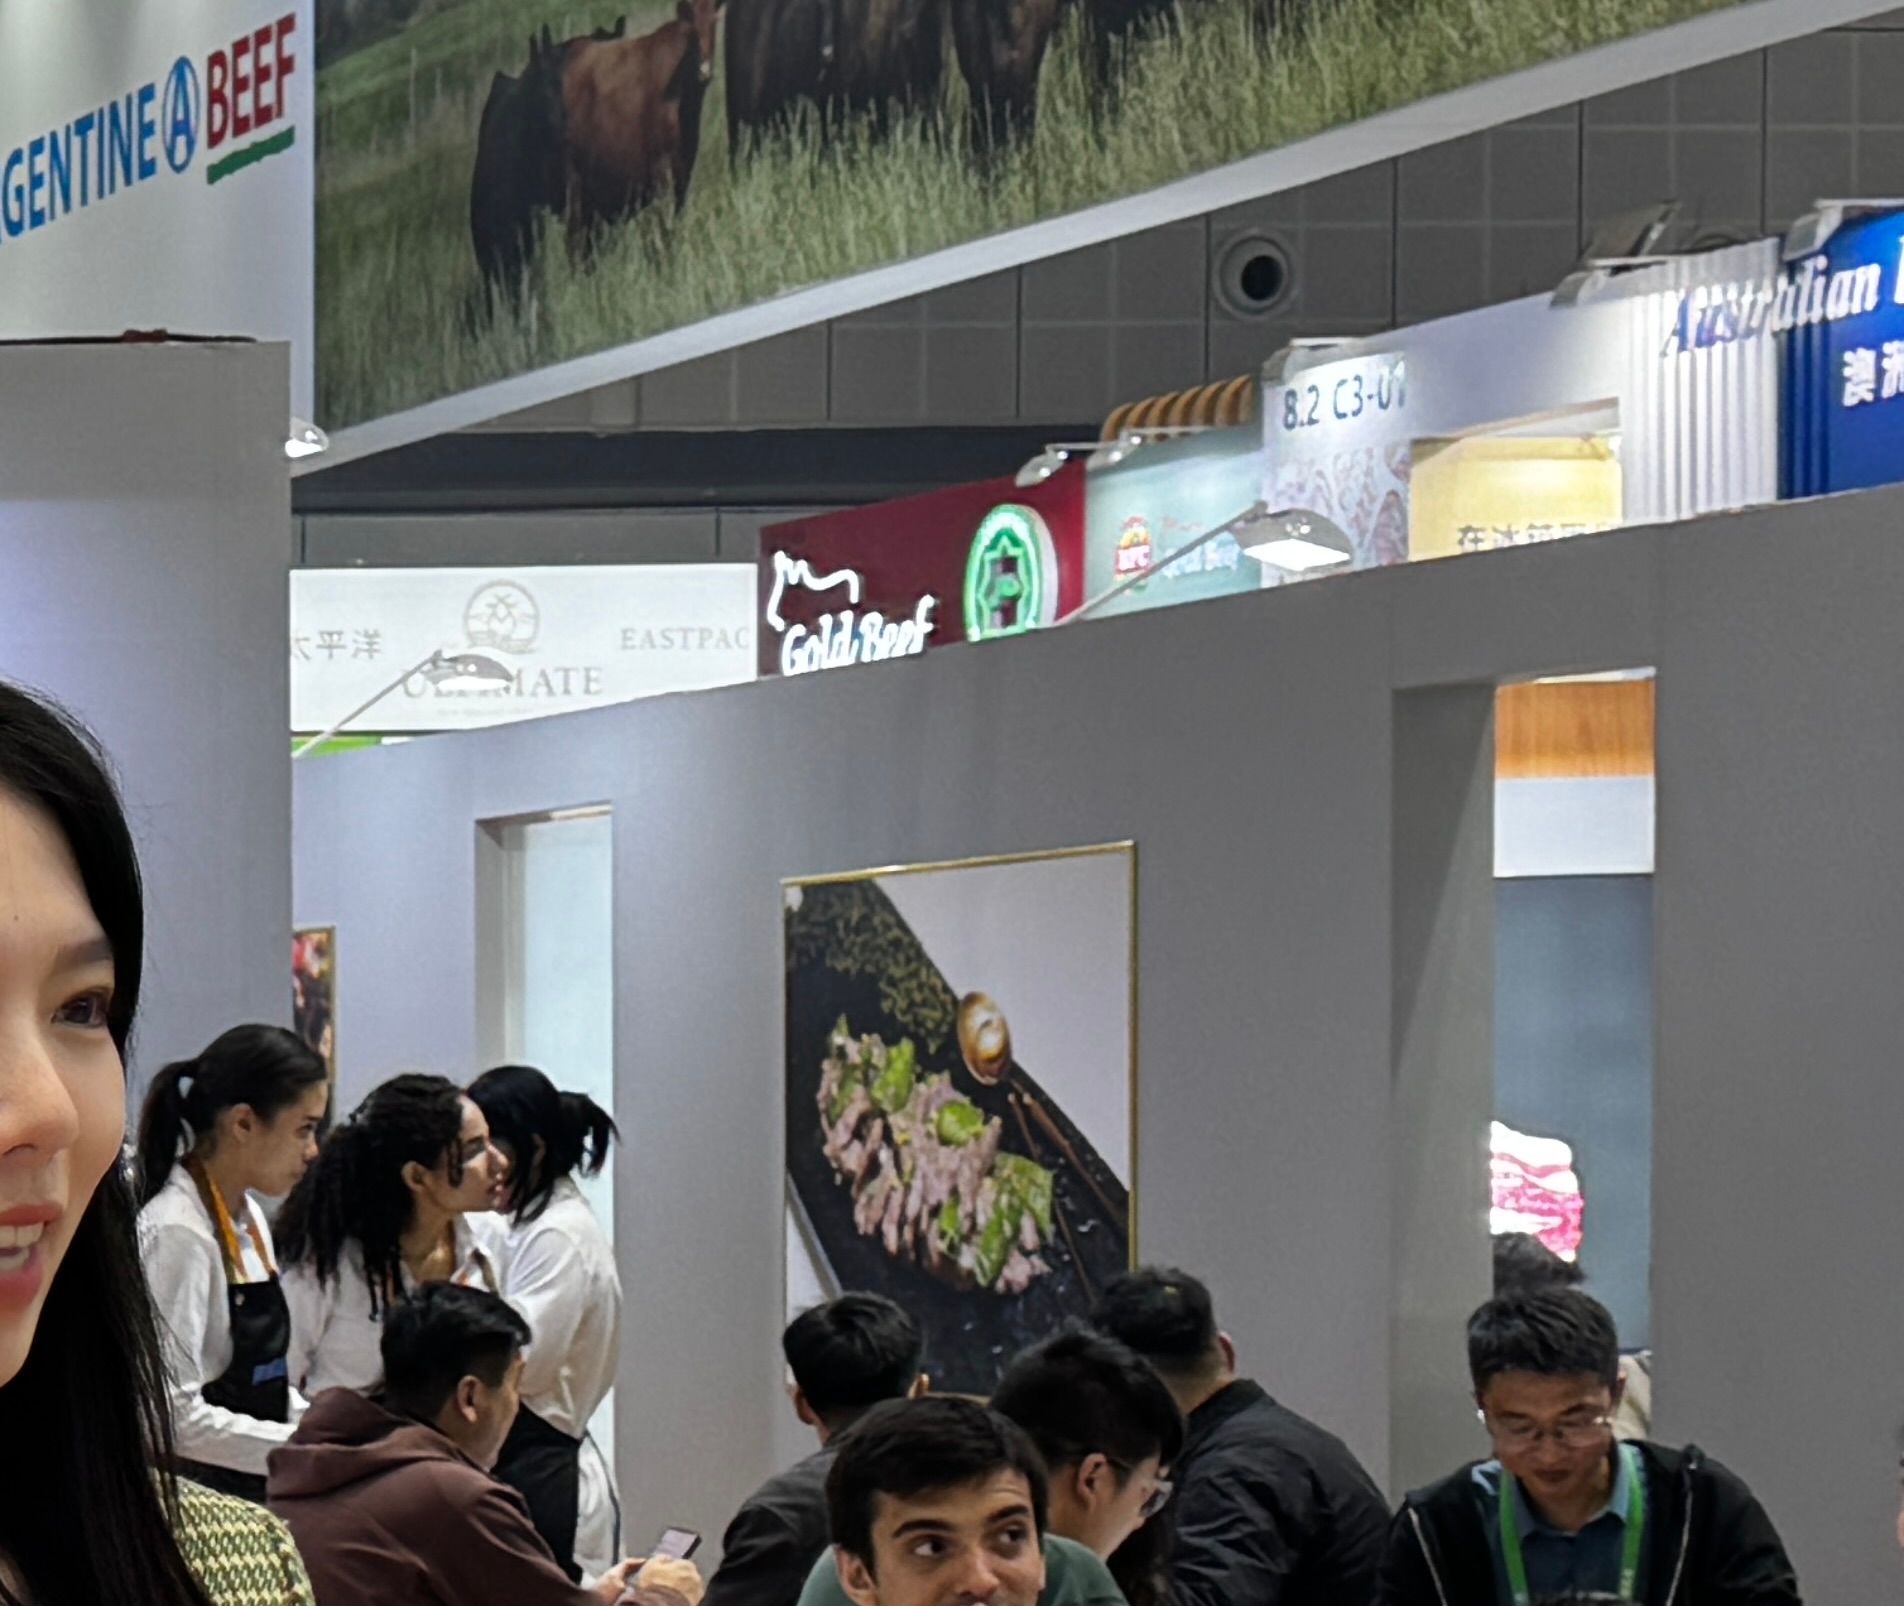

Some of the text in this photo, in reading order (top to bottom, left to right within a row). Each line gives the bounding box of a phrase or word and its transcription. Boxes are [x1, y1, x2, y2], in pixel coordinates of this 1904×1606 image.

[207, 12, 296, 149] BEEF
[1660, 254, 1881, 358] Australian
[1283, 384, 1320, 430] 8.2
[621, 626, 750, 652] EASTPAC
[782, 594, 938, 676] Gold Beef
